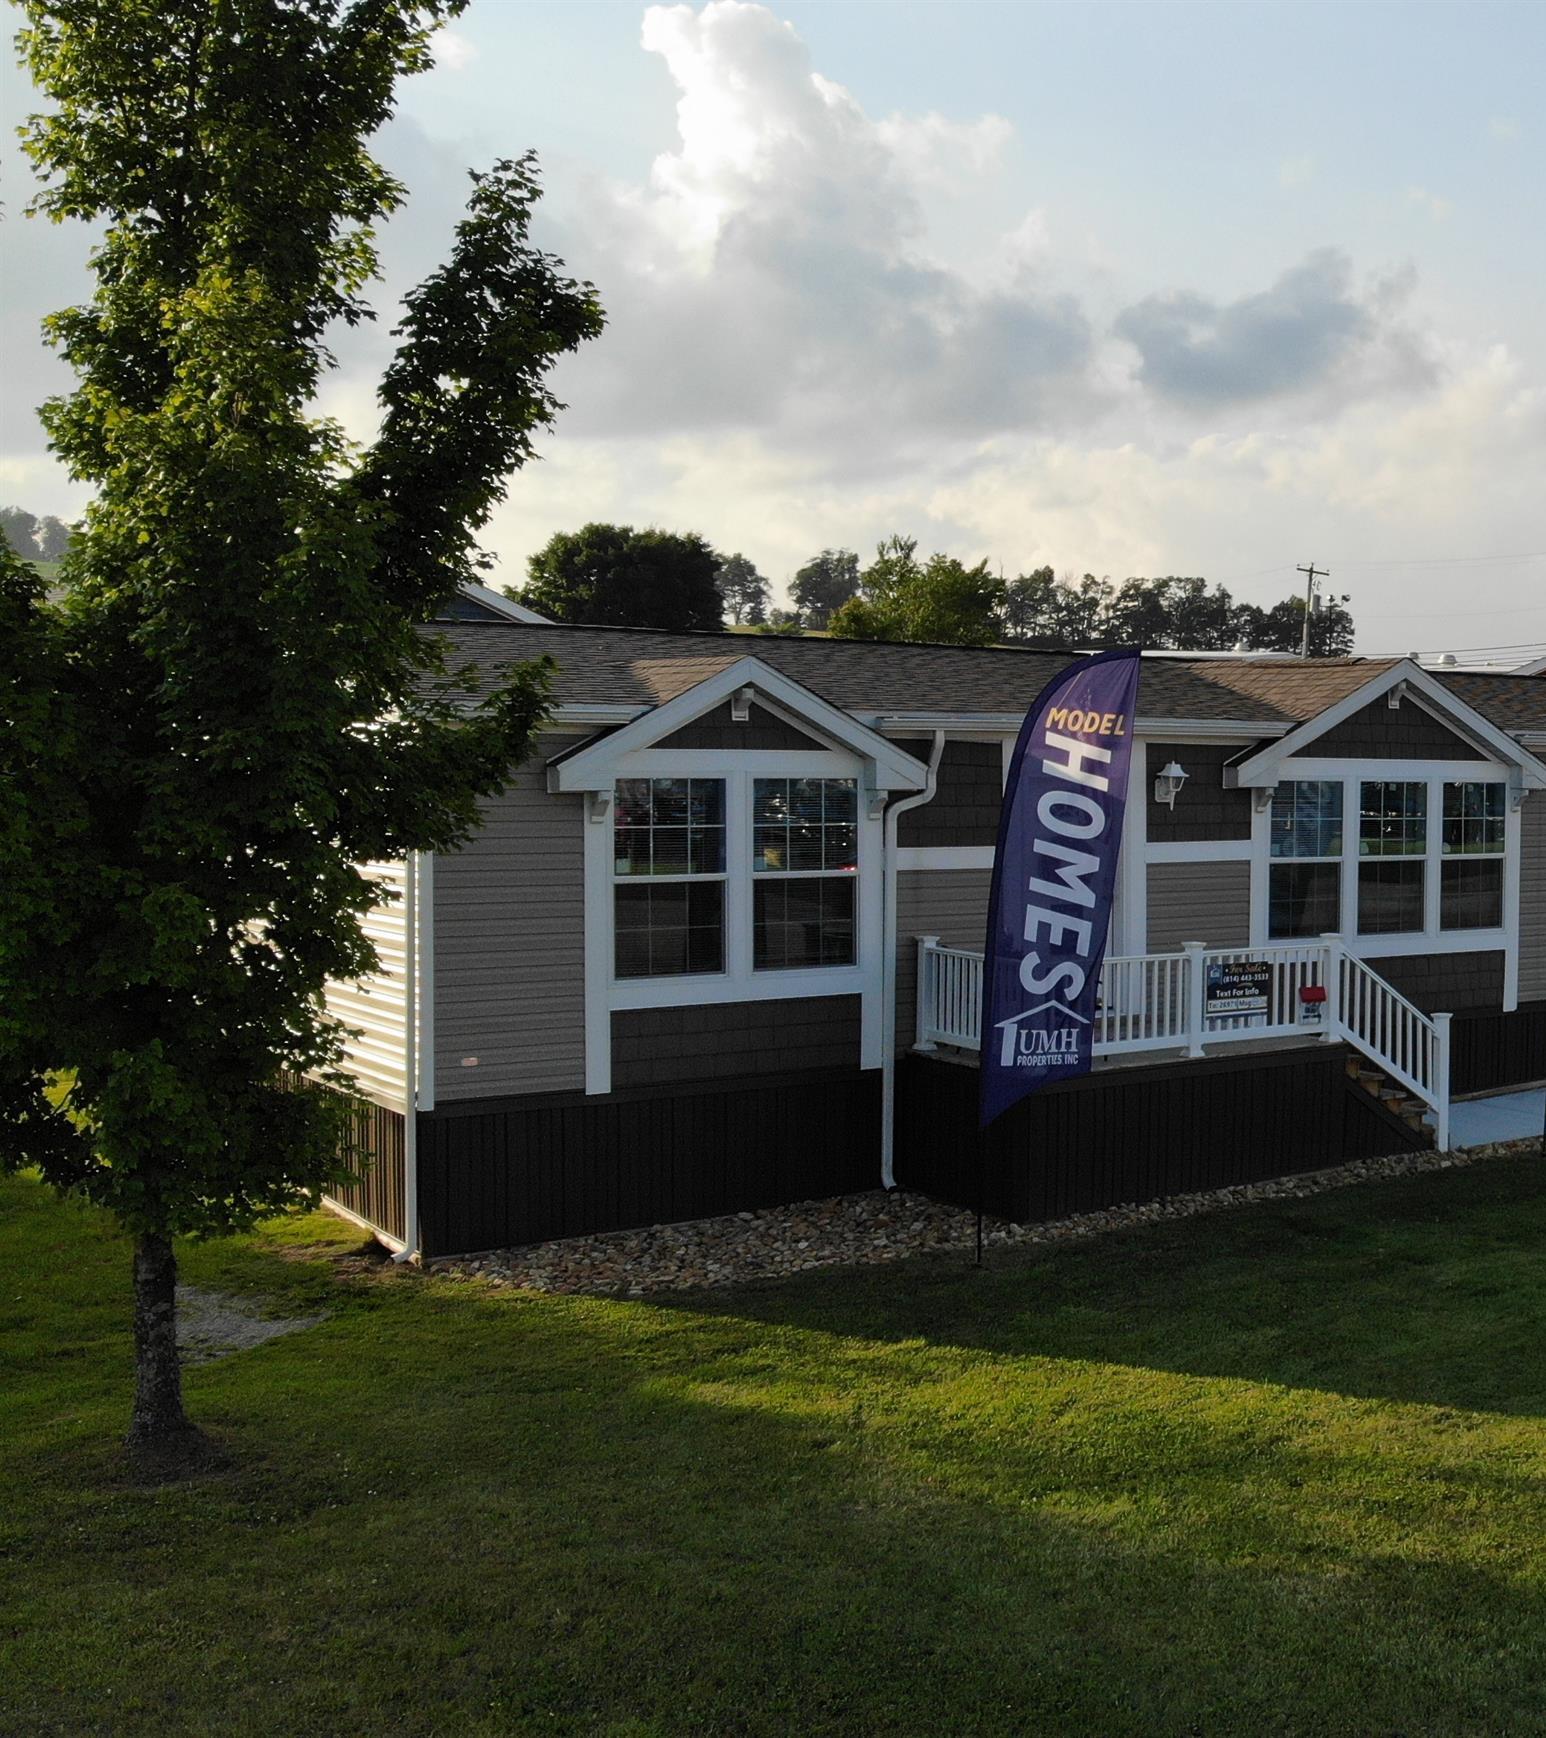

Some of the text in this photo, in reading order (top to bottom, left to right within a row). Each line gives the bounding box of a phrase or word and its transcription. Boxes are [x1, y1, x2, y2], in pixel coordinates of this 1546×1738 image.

[1045, 707, 1125, 736] MODEL
[1019, 731, 1112, 1001] HOMES
[1232, 988, 1244, 996] For
[1245, 987, 1259, 996] Info
[1018, 1027, 1079, 1055] UMH
[1017, 1053, 1062, 1067] PROPERTIES
